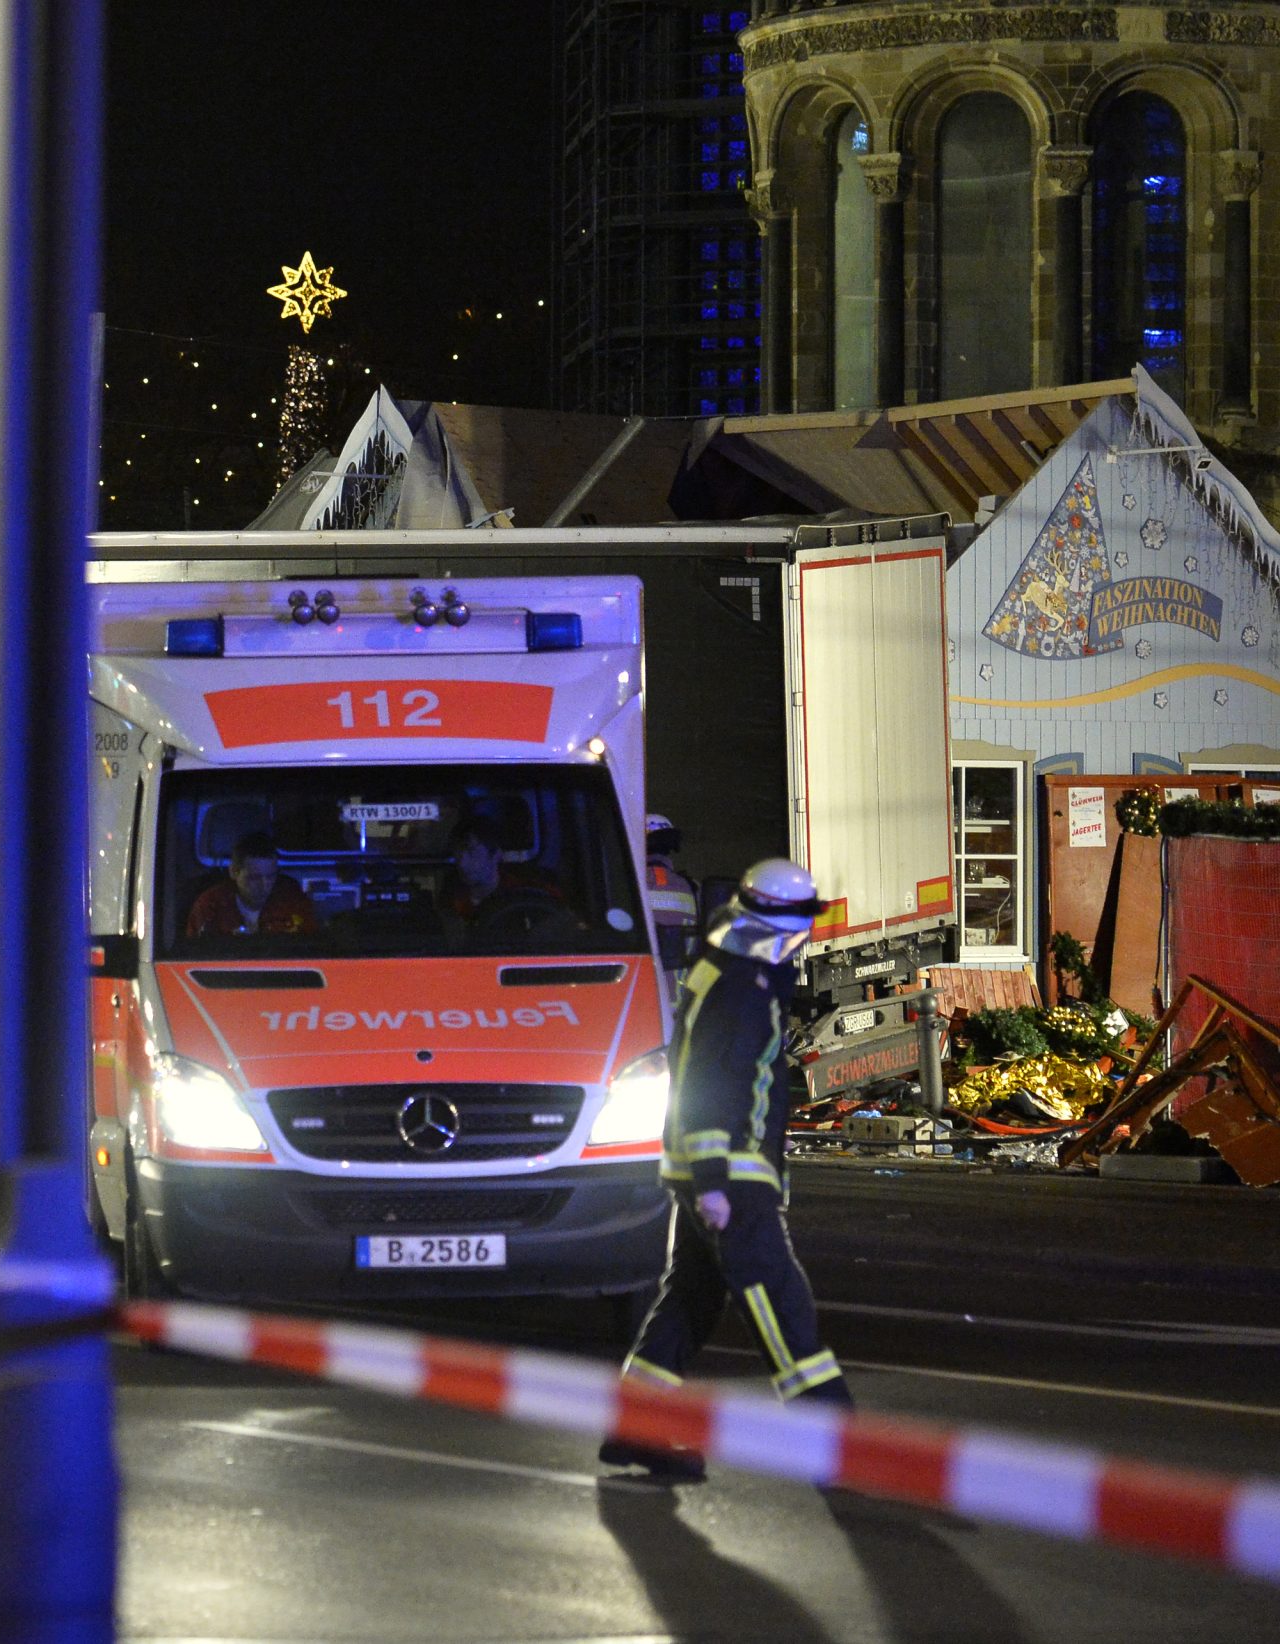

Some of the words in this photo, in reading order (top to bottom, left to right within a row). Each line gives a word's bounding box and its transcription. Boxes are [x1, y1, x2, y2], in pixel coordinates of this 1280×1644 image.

[1093, 578, 1204, 618] FASZINATION
[1097, 602, 1220, 638] WEIHNACHTEN
[327, 690, 442, 728] 112
[95, 733, 128, 751] 2008
[350, 807, 379, 818] RTW
[383, 805, 433, 818] 1300/1
[388, 1240, 403, 1263] B
[421, 1239, 489, 1263] 2586
